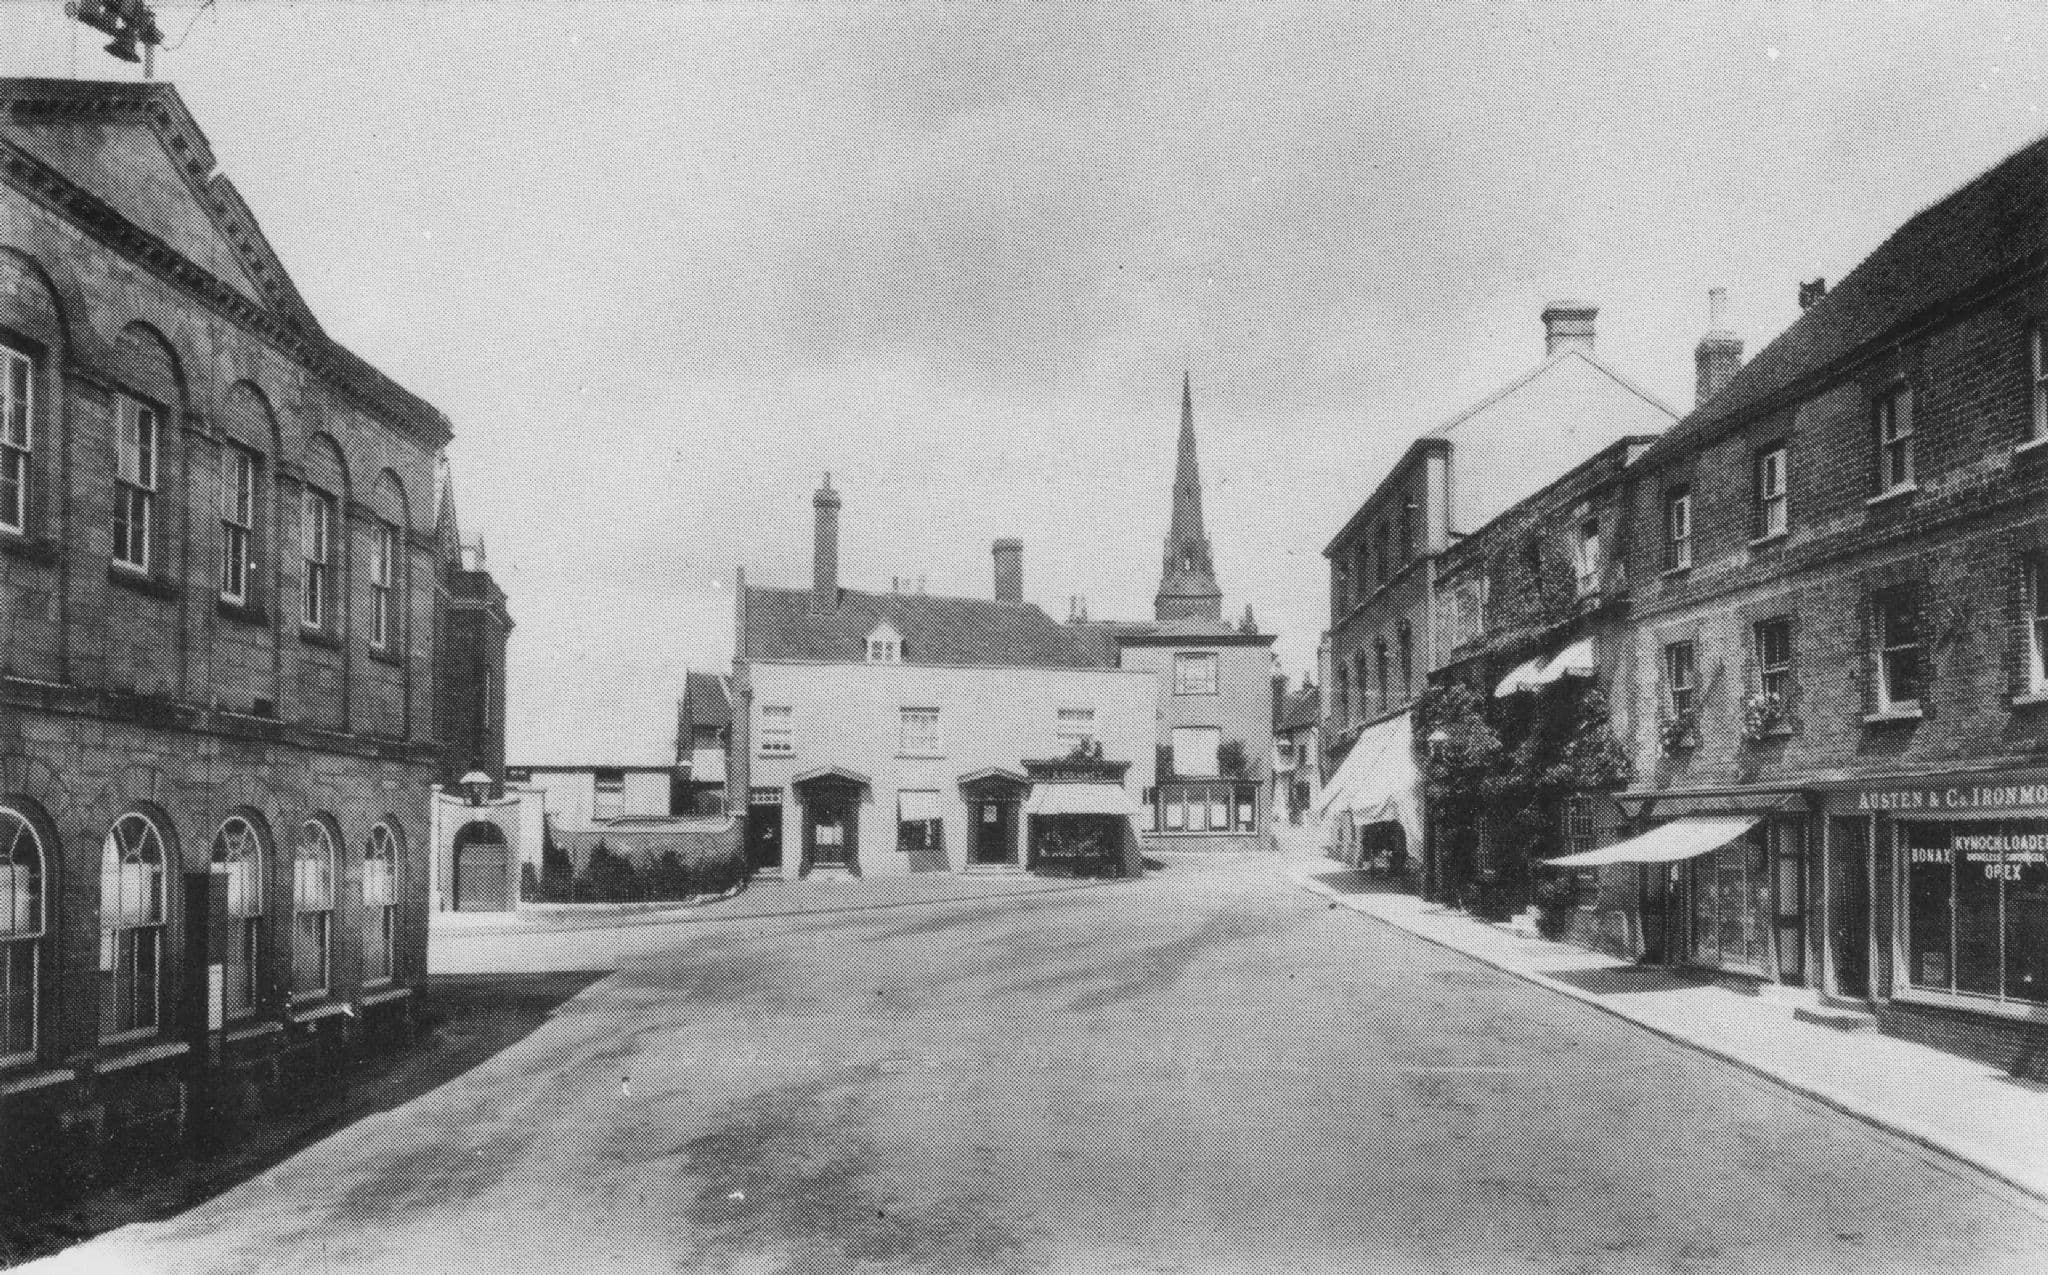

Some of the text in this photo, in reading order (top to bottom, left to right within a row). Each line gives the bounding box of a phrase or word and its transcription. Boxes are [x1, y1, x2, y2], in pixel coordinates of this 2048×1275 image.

[1858, 792, 1922, 809] AUSTEN
[1929, 791, 1940, 807] &
[1954, 834, 2048, 852] KYNOCH LOADE
[1911, 848, 1951, 863] BONAX
[1984, 864, 2021, 881] OPEX
